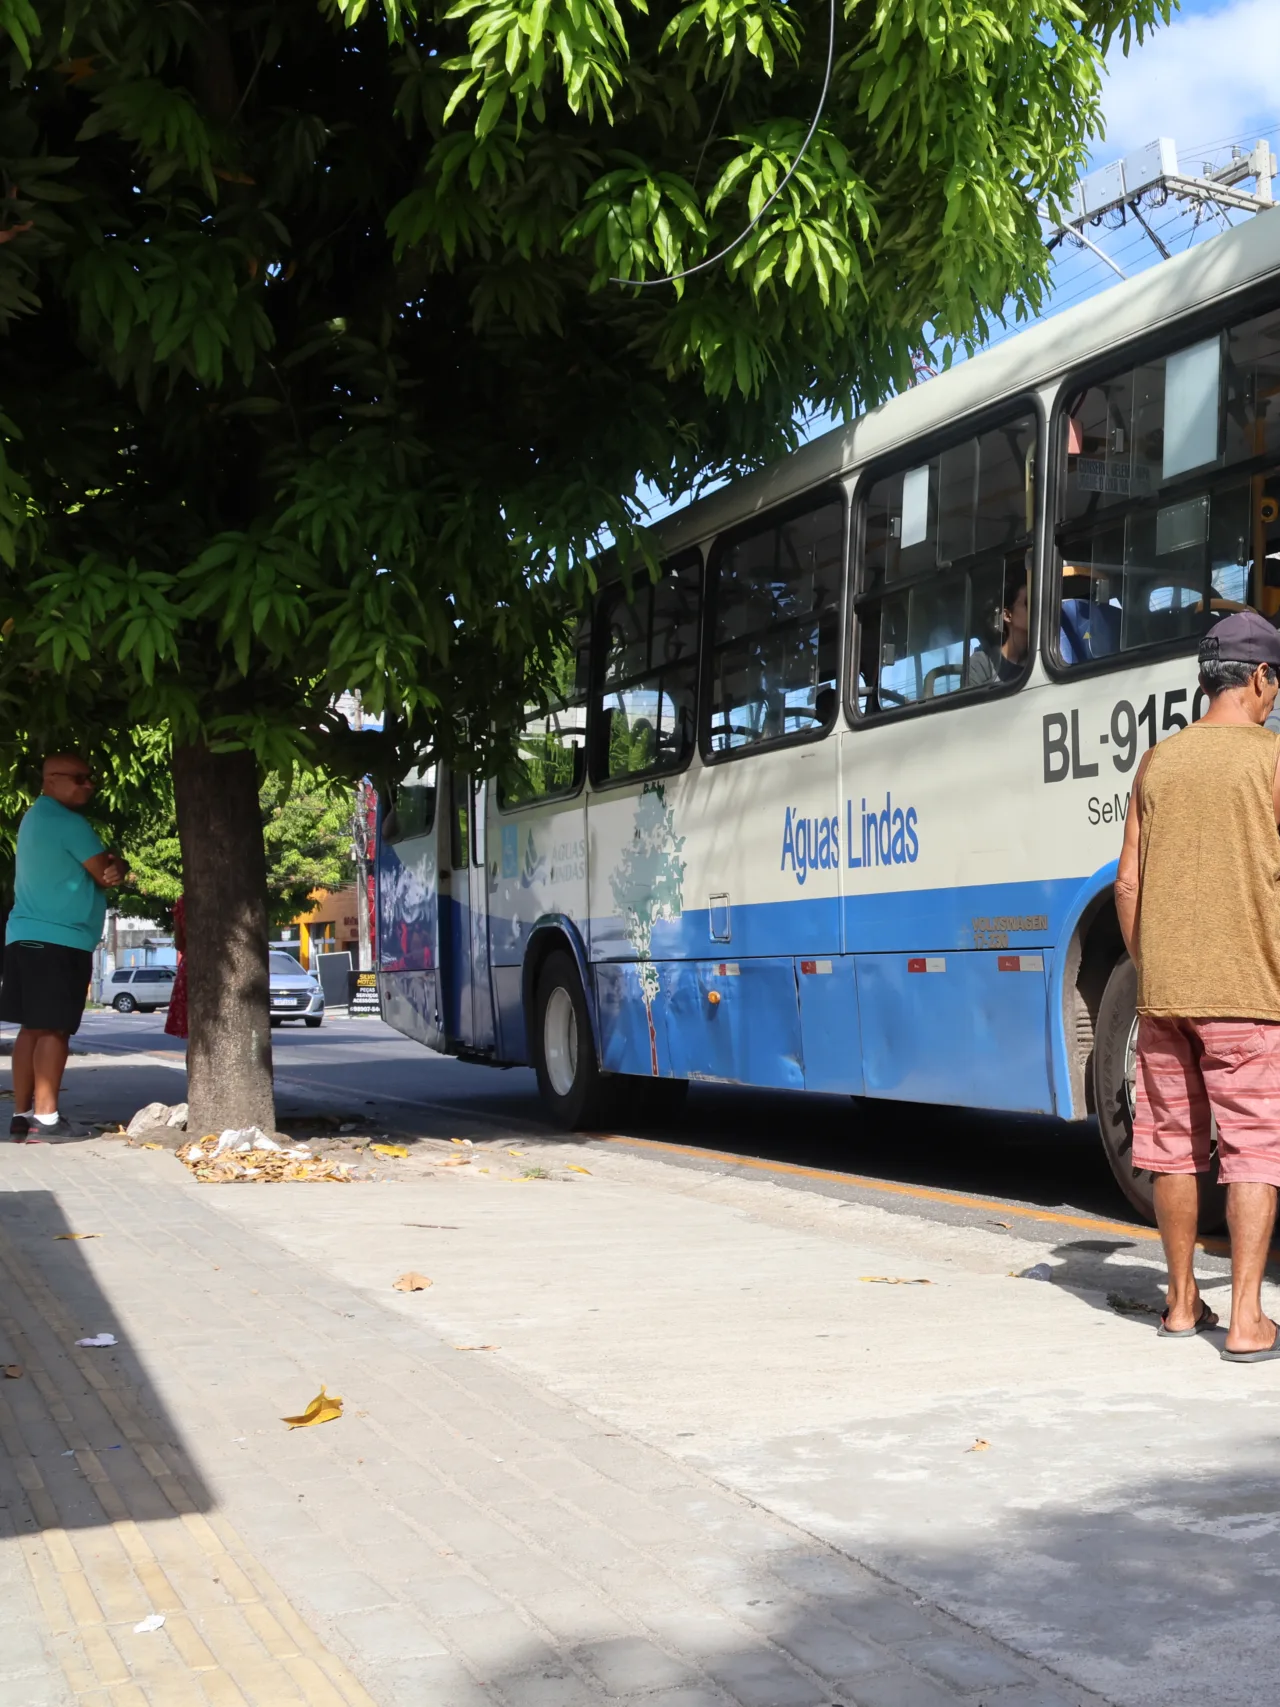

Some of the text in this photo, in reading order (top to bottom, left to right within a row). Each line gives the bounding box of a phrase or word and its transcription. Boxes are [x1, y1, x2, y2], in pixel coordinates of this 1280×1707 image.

[781, 791, 919, 885] Águas Lindas
[972, 915, 1048, 932] VOLKSWAGEN
